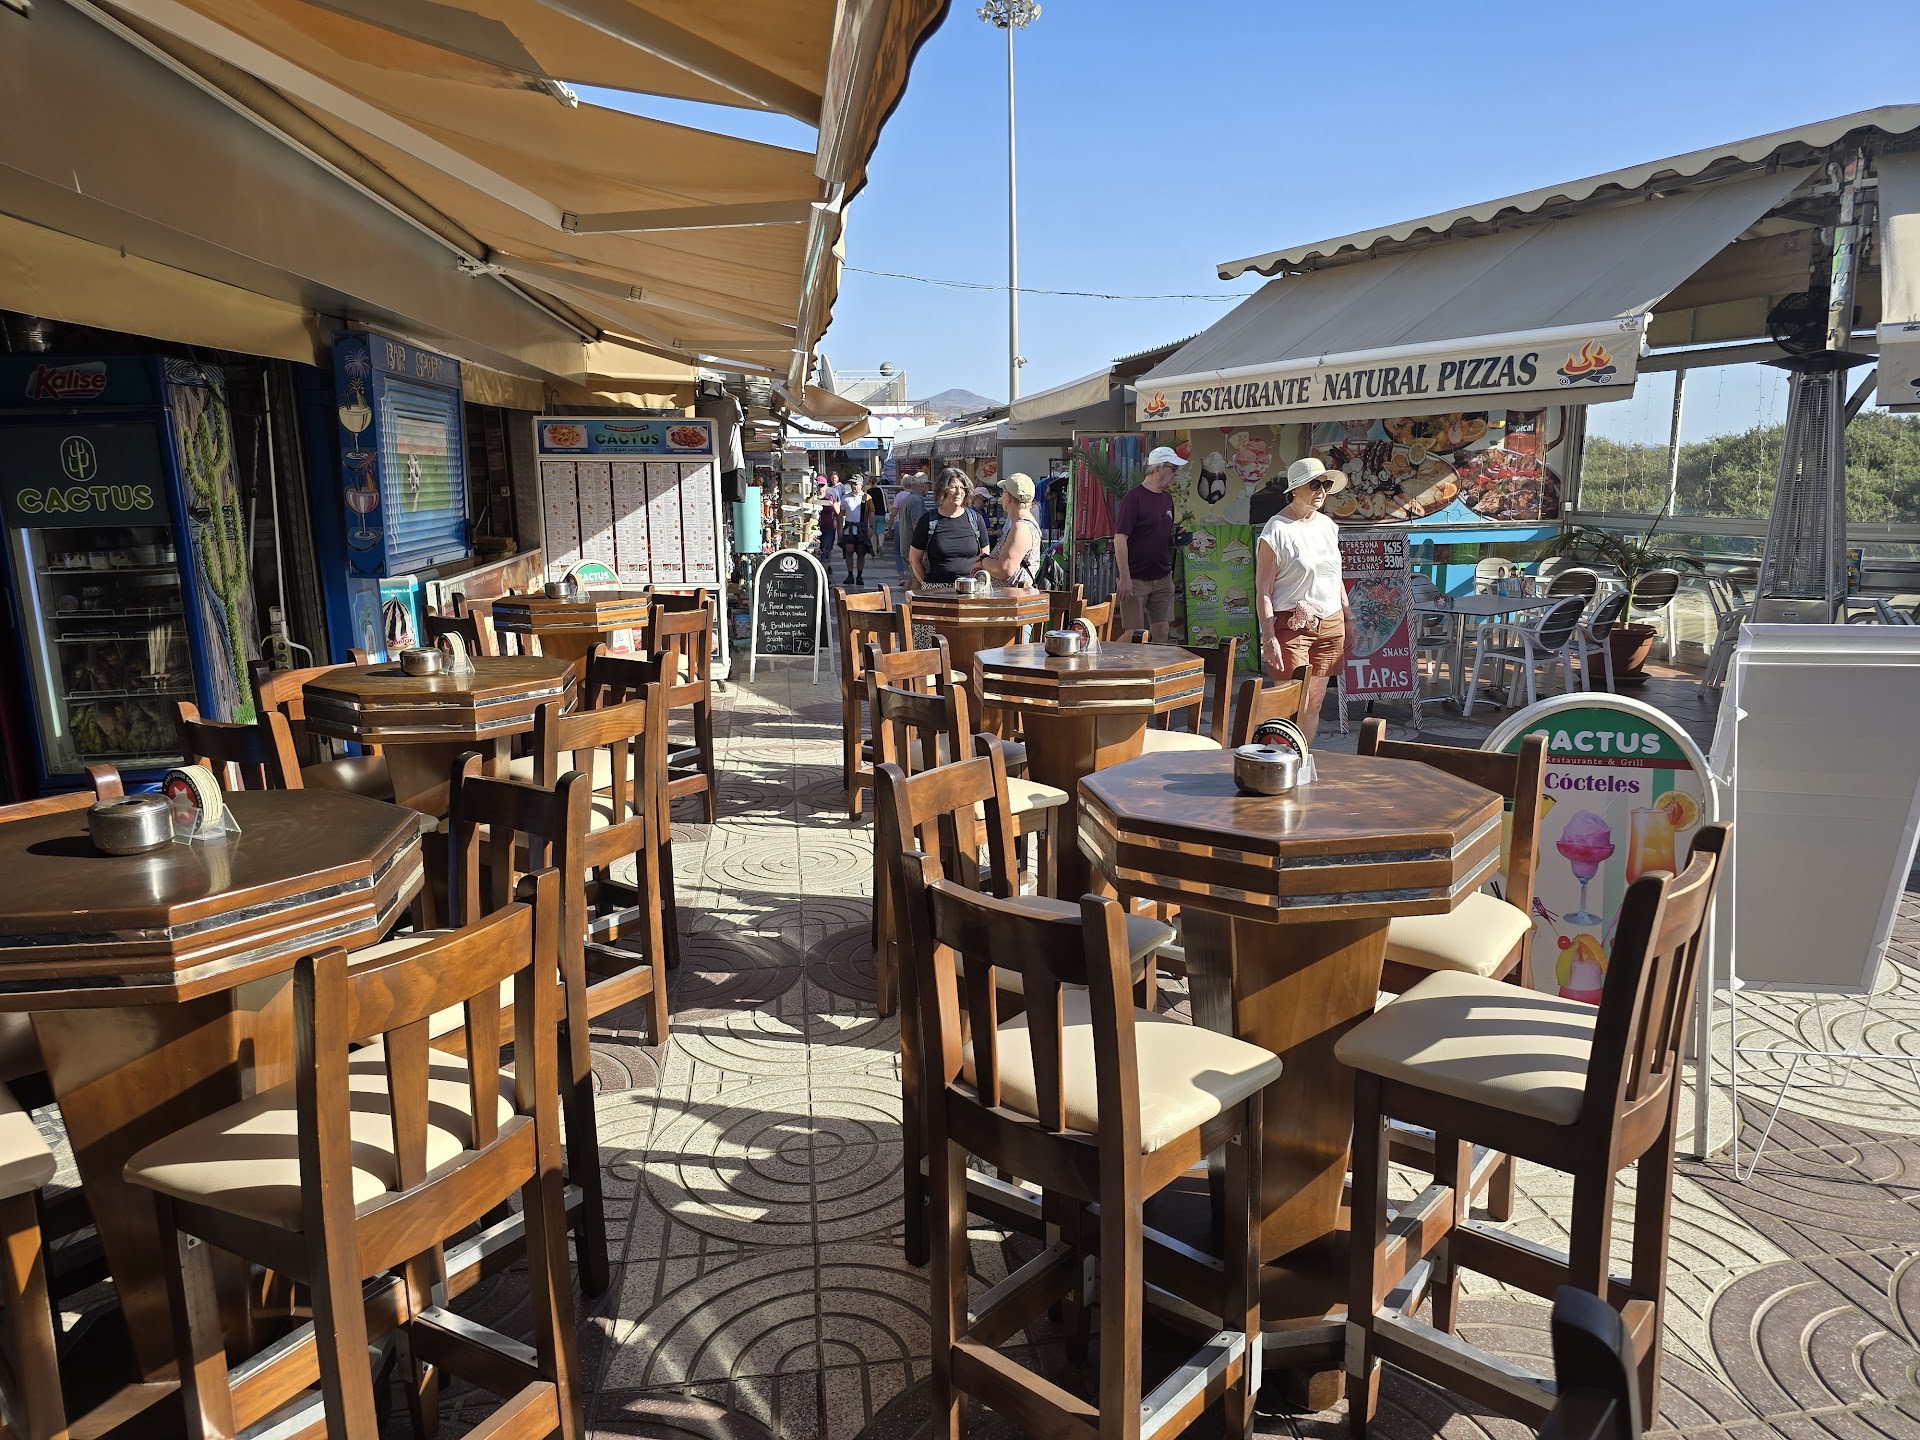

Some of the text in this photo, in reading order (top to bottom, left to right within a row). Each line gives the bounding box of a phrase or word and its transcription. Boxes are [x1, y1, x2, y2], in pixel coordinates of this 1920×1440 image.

[386, 342, 442, 380] BAR SPORT
[33, 364, 107, 399] Kalise
[1180, 352, 1539, 413] RESTAURANTE NATURAL PIZZAS
[1508, 422, 1534, 433] Tropical
[594, 432, 660, 445] CACTUS
[17, 485, 154, 513] CACTUS
[1345, 541, 1379, 549] PERSONA
[1348, 556, 1383, 564] PERSONAS
[1383, 647, 1409, 657] SNAKS
[1347, 659, 1409, 689] TAPAS
[1546, 755, 1603, 765] Restaurante
[1544, 772, 1640, 793] Cócteles
